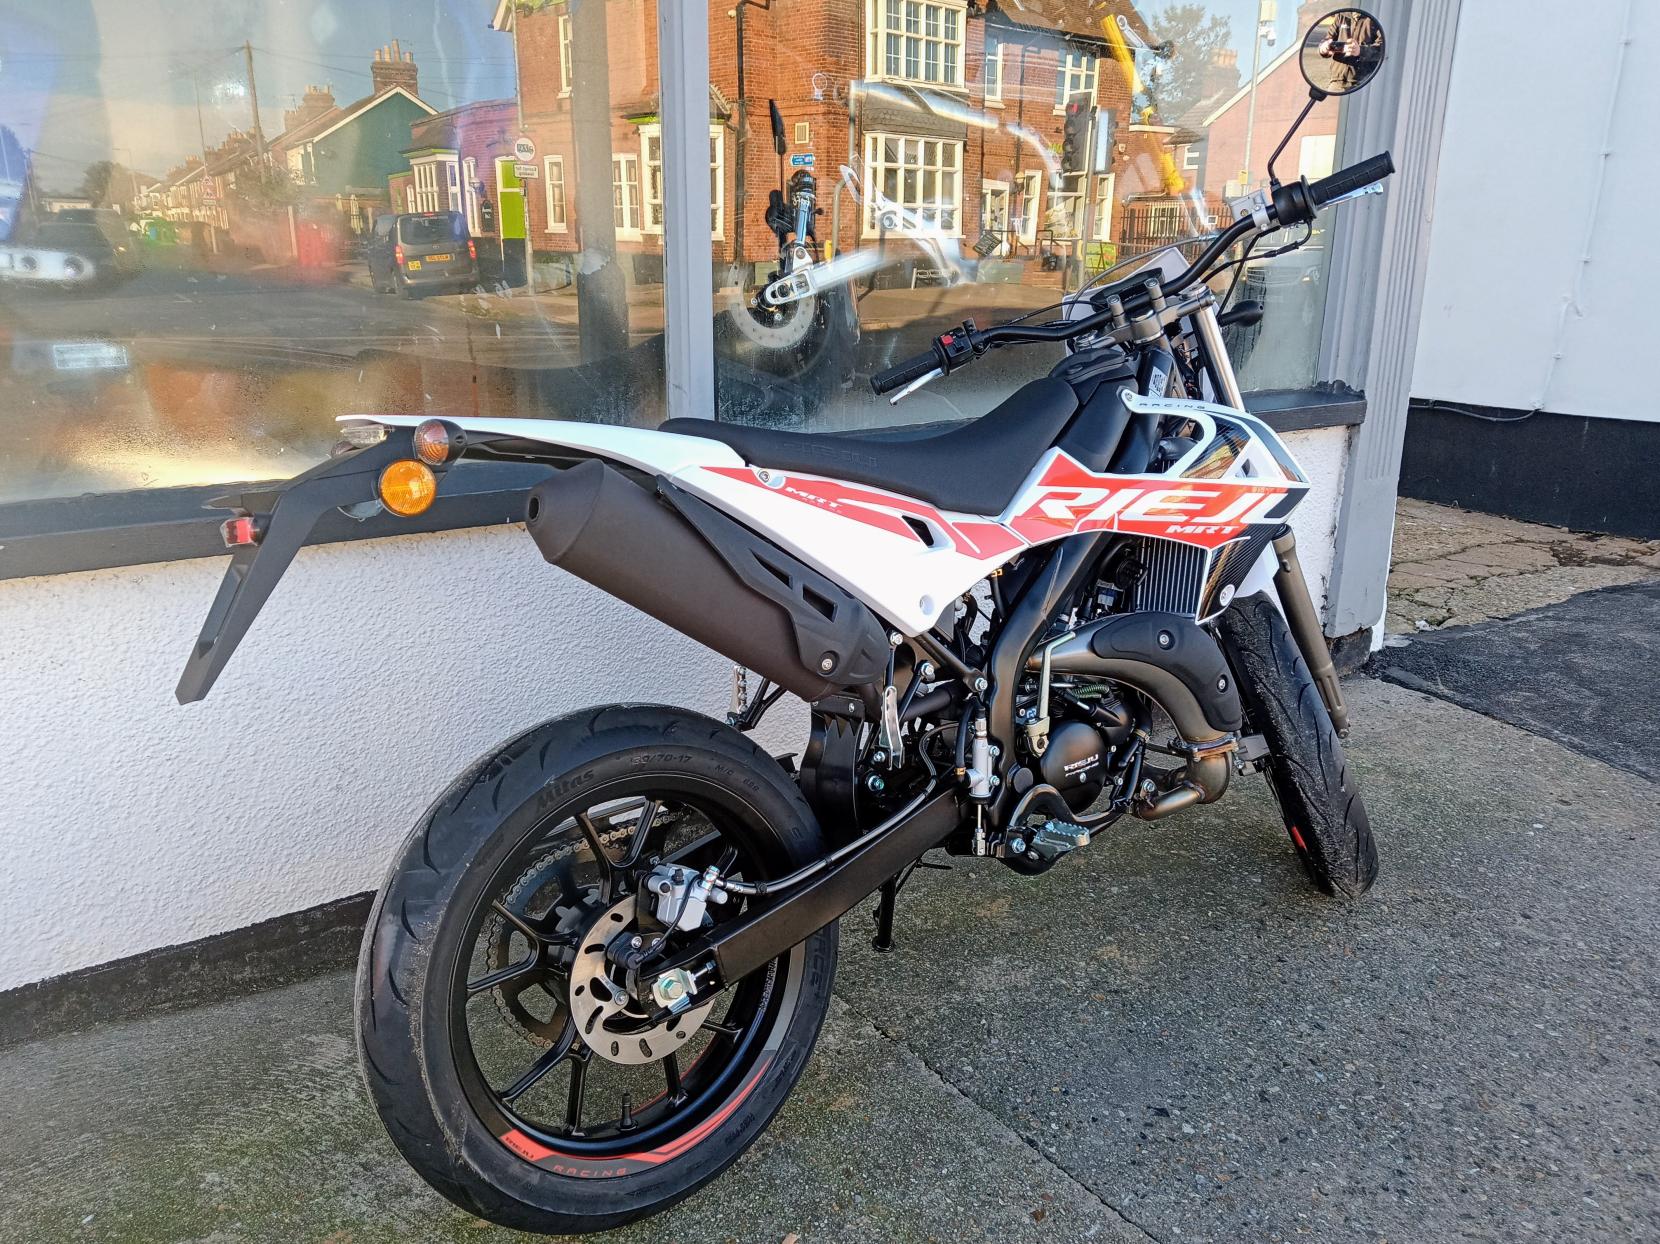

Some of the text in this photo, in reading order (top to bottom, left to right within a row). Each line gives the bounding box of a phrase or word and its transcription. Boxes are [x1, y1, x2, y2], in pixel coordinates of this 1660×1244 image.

[1138, 402, 1206, 411] RACING
[784, 486, 843, 509] MRT
[1164, 524, 1240, 536] MRT
[552, 1164, 630, 1179] RACING
